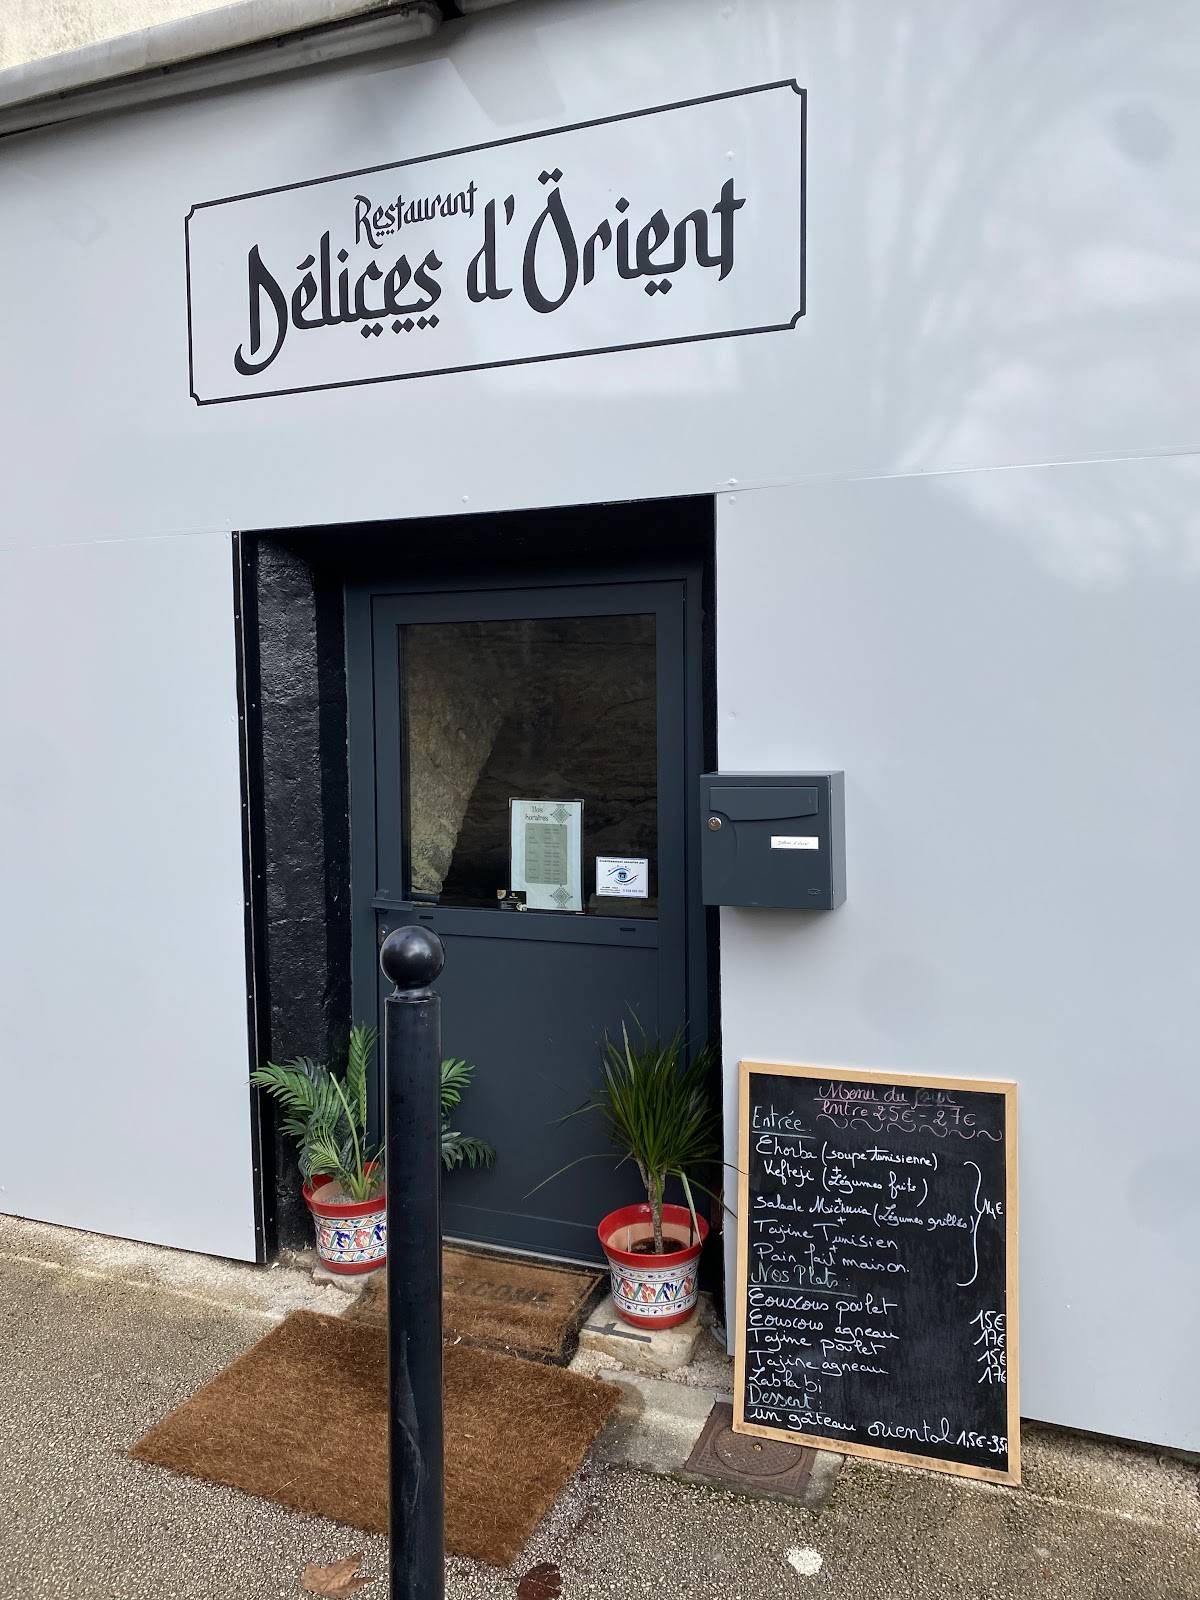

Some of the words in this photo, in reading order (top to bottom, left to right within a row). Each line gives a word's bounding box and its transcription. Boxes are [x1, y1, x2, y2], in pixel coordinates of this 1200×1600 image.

[353, 180, 478, 250] Restaurant
[234, 244, 443, 376] Délices
[818, 1082, 878, 1101] Menu
[883, 1086, 908, 1103] du
[823, 1100, 868, 1116] entre
[873, 1106, 916, 1122] 25€
[933, 1108, 977, 1127] 27€
[822, 1141, 867, 1169] (soupe
[753, 1194, 804, 1212] Salade
[753, 1219, 814, 1244] Tajine
[813, 1222, 899, 1250] Tunisien
[753, 1243, 797, 1263] Pain
[751, 1261, 790, 1283] Nos
[835, 1293, 898, 1325] poulet
[969, 1309, 1006, 1331] 15€
[747, 1327, 812, 1351] Tajine
[820, 1338, 887, 1358] poulet
[833, 1326, 900, 1344] agneau
[973, 1329, 1006, 1348] 17€
[748, 1350, 819, 1373] Tajine
[820, 1361, 890, 1377] agneau
[977, 1348, 1007, 1366] 15€
[750, 1408, 783, 1422] un
[787, 1412, 857, 1431] gâteau
[867, 1417, 956, 1445] oriental
